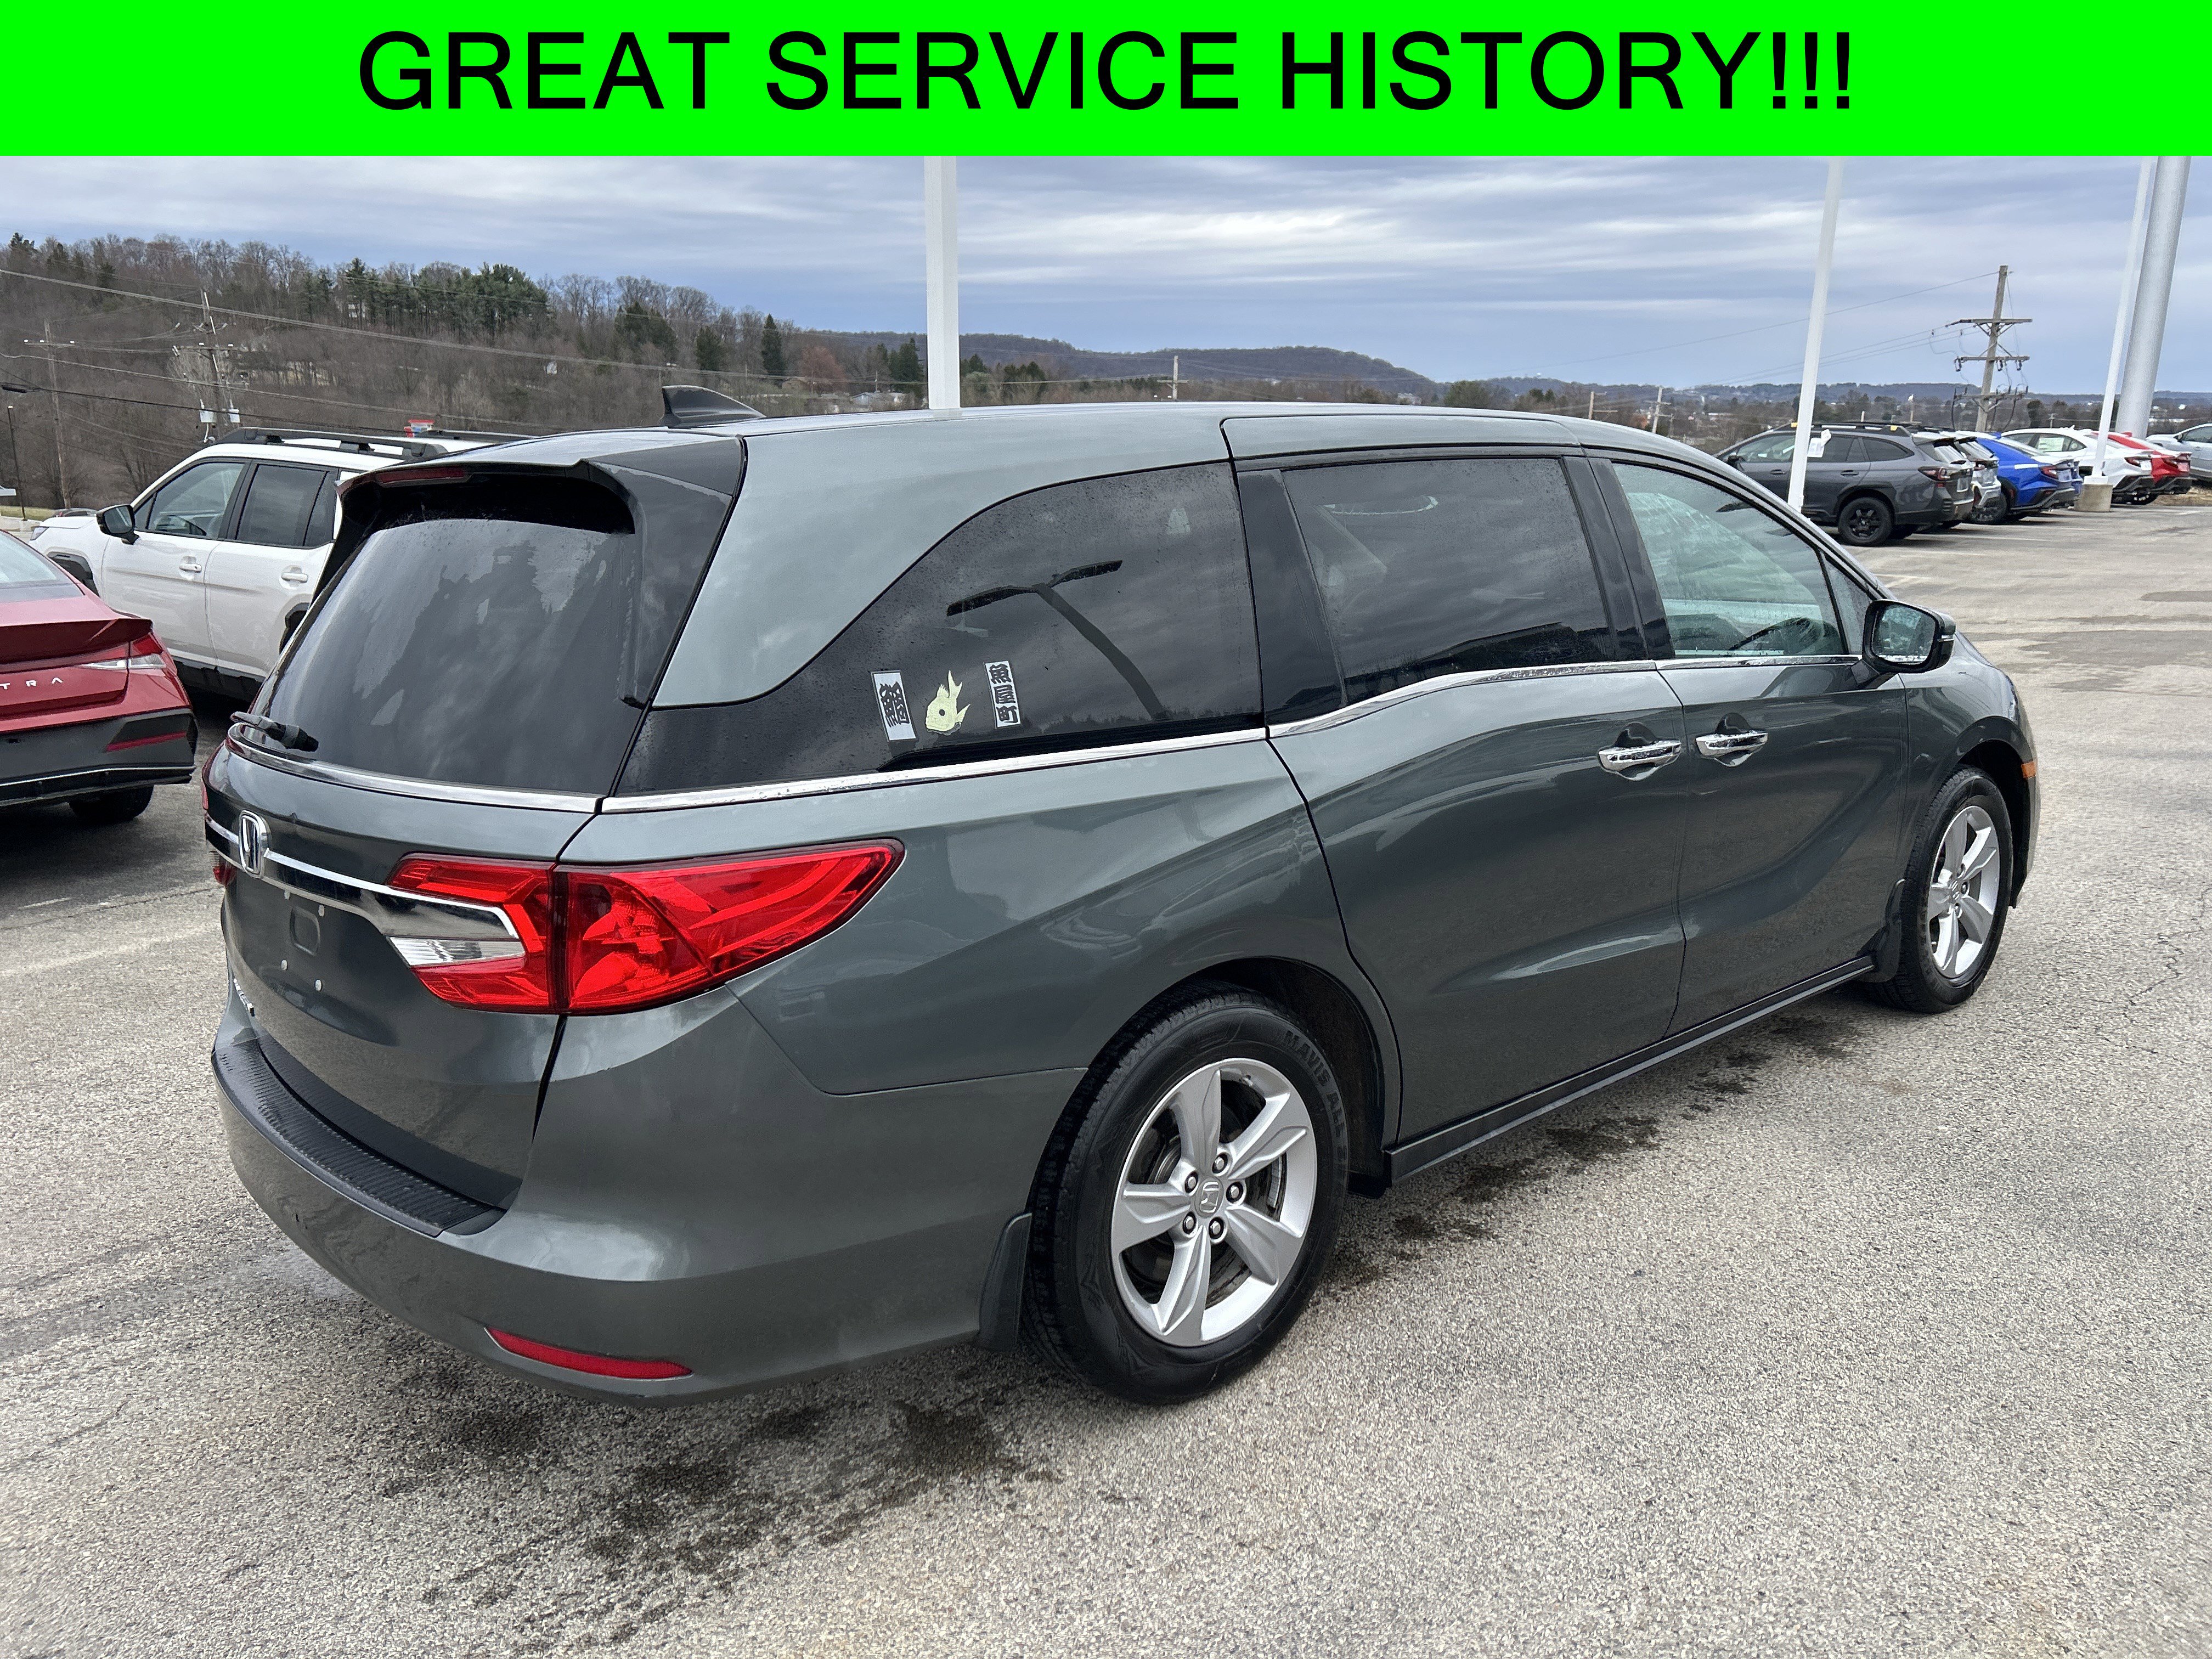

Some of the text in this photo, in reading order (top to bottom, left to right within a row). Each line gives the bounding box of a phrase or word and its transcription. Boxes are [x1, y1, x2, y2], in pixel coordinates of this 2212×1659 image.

[988, 663, 1018, 724] 魚屋町
[1282, 1029, 1332, 1087] MAVIS
